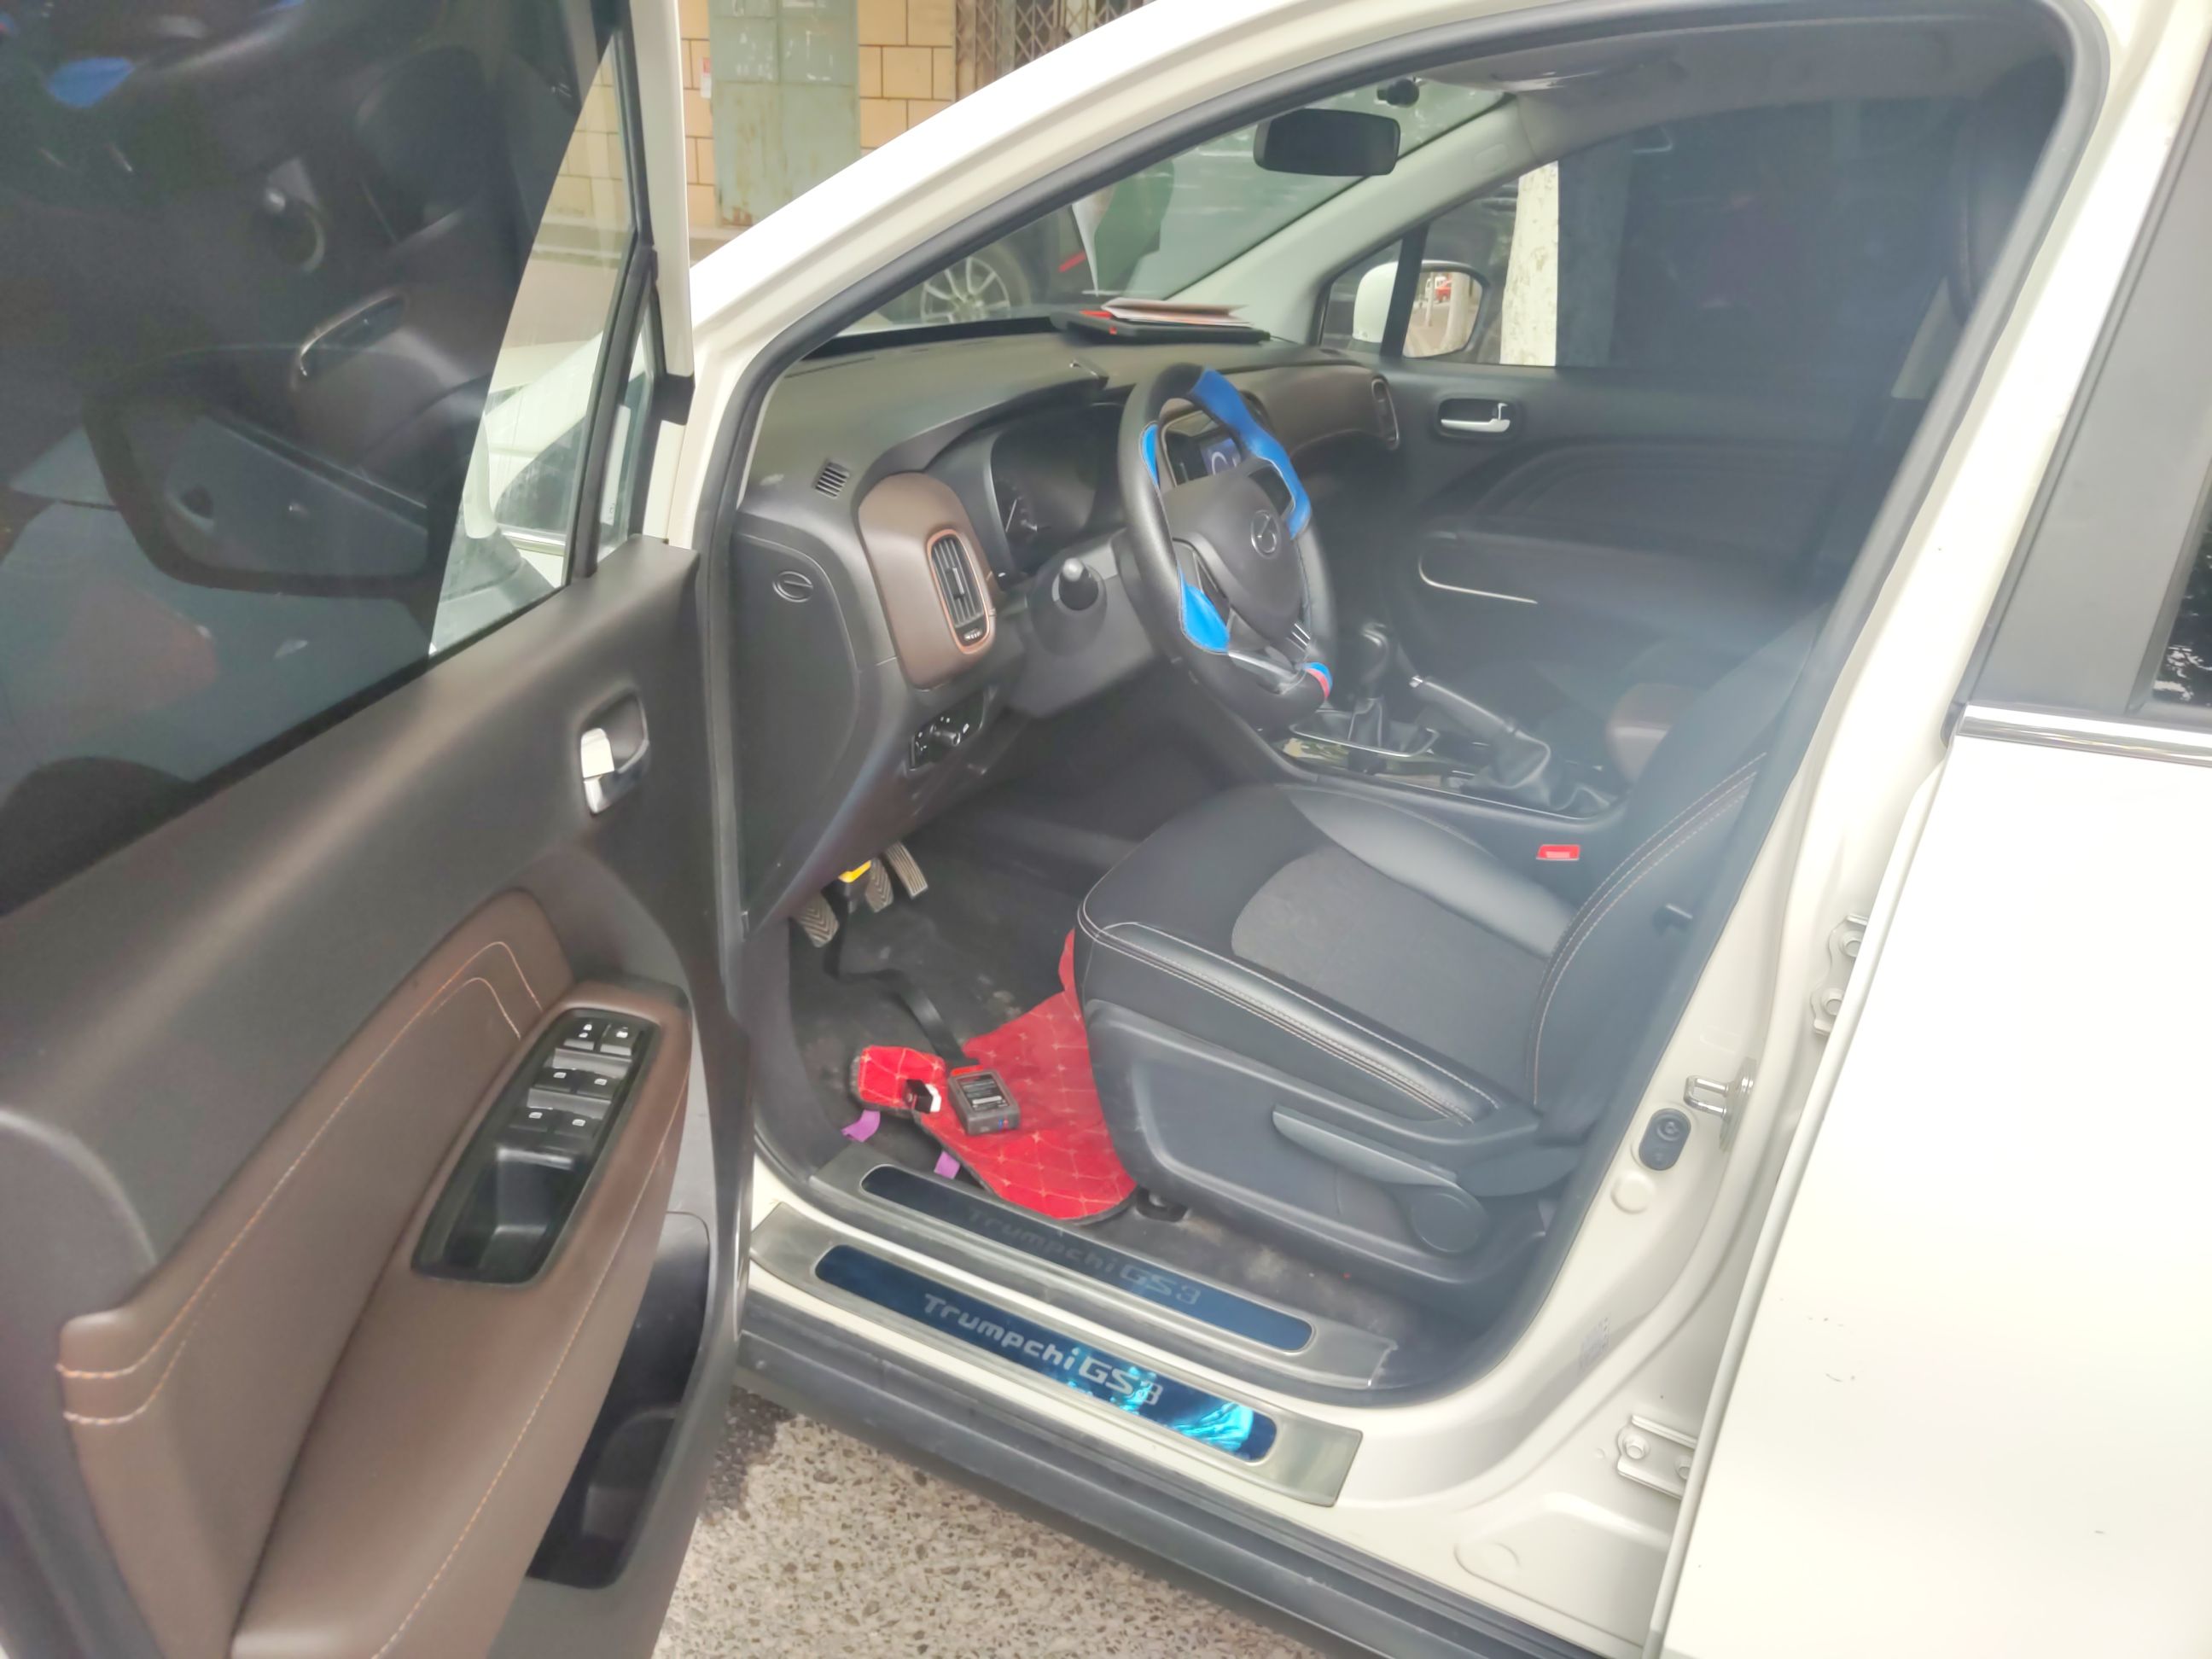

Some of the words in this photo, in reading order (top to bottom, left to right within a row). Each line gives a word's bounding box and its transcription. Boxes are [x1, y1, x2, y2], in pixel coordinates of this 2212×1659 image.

[968, 1208, 1118, 1272] Trumpchi
[1120, 1263, 1201, 1305] GS3
[924, 1292, 1079, 1370] Trumpchi
[1078, 1355, 1163, 1406] GS3
